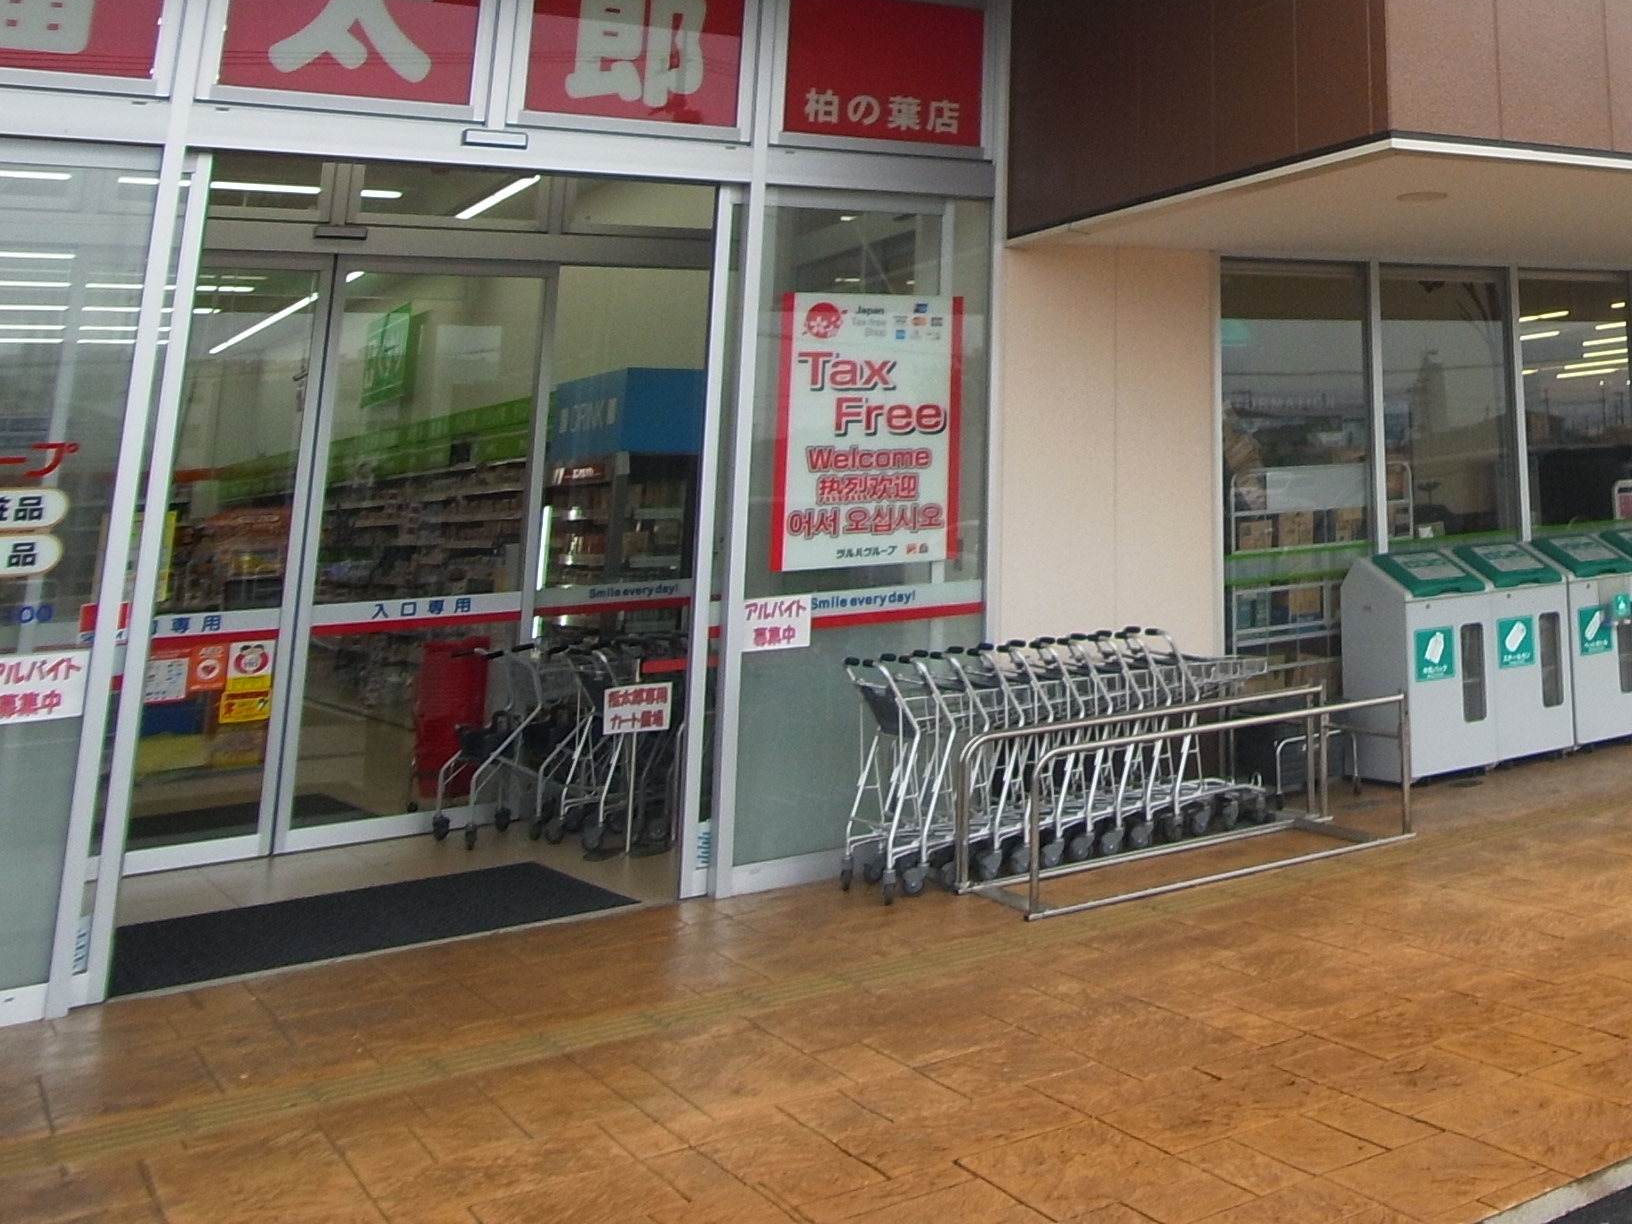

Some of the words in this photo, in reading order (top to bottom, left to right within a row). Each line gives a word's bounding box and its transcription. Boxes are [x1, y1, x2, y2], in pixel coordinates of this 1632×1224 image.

[804, 87, 960, 135] 柏の葉店
[855, 306, 885, 316] Japan
[797, 351, 897, 392] Tax
[834, 396, 948, 437] Free
[806, 445, 932, 473] Welcome
[816, 472, 920, 506] 热烈欢迎
[787, 507, 841, 540] 어서
[843, 503, 945, 533] 오십시오
[589, 587, 621, 599] Smile
[811, 596, 848, 610] Smile
[371, 598, 471, 620] 入口専用
[745, 599, 806, 621] アルバイト
[152, 615, 221, 634] 専用
[753, 626, 796, 646] 募集中
